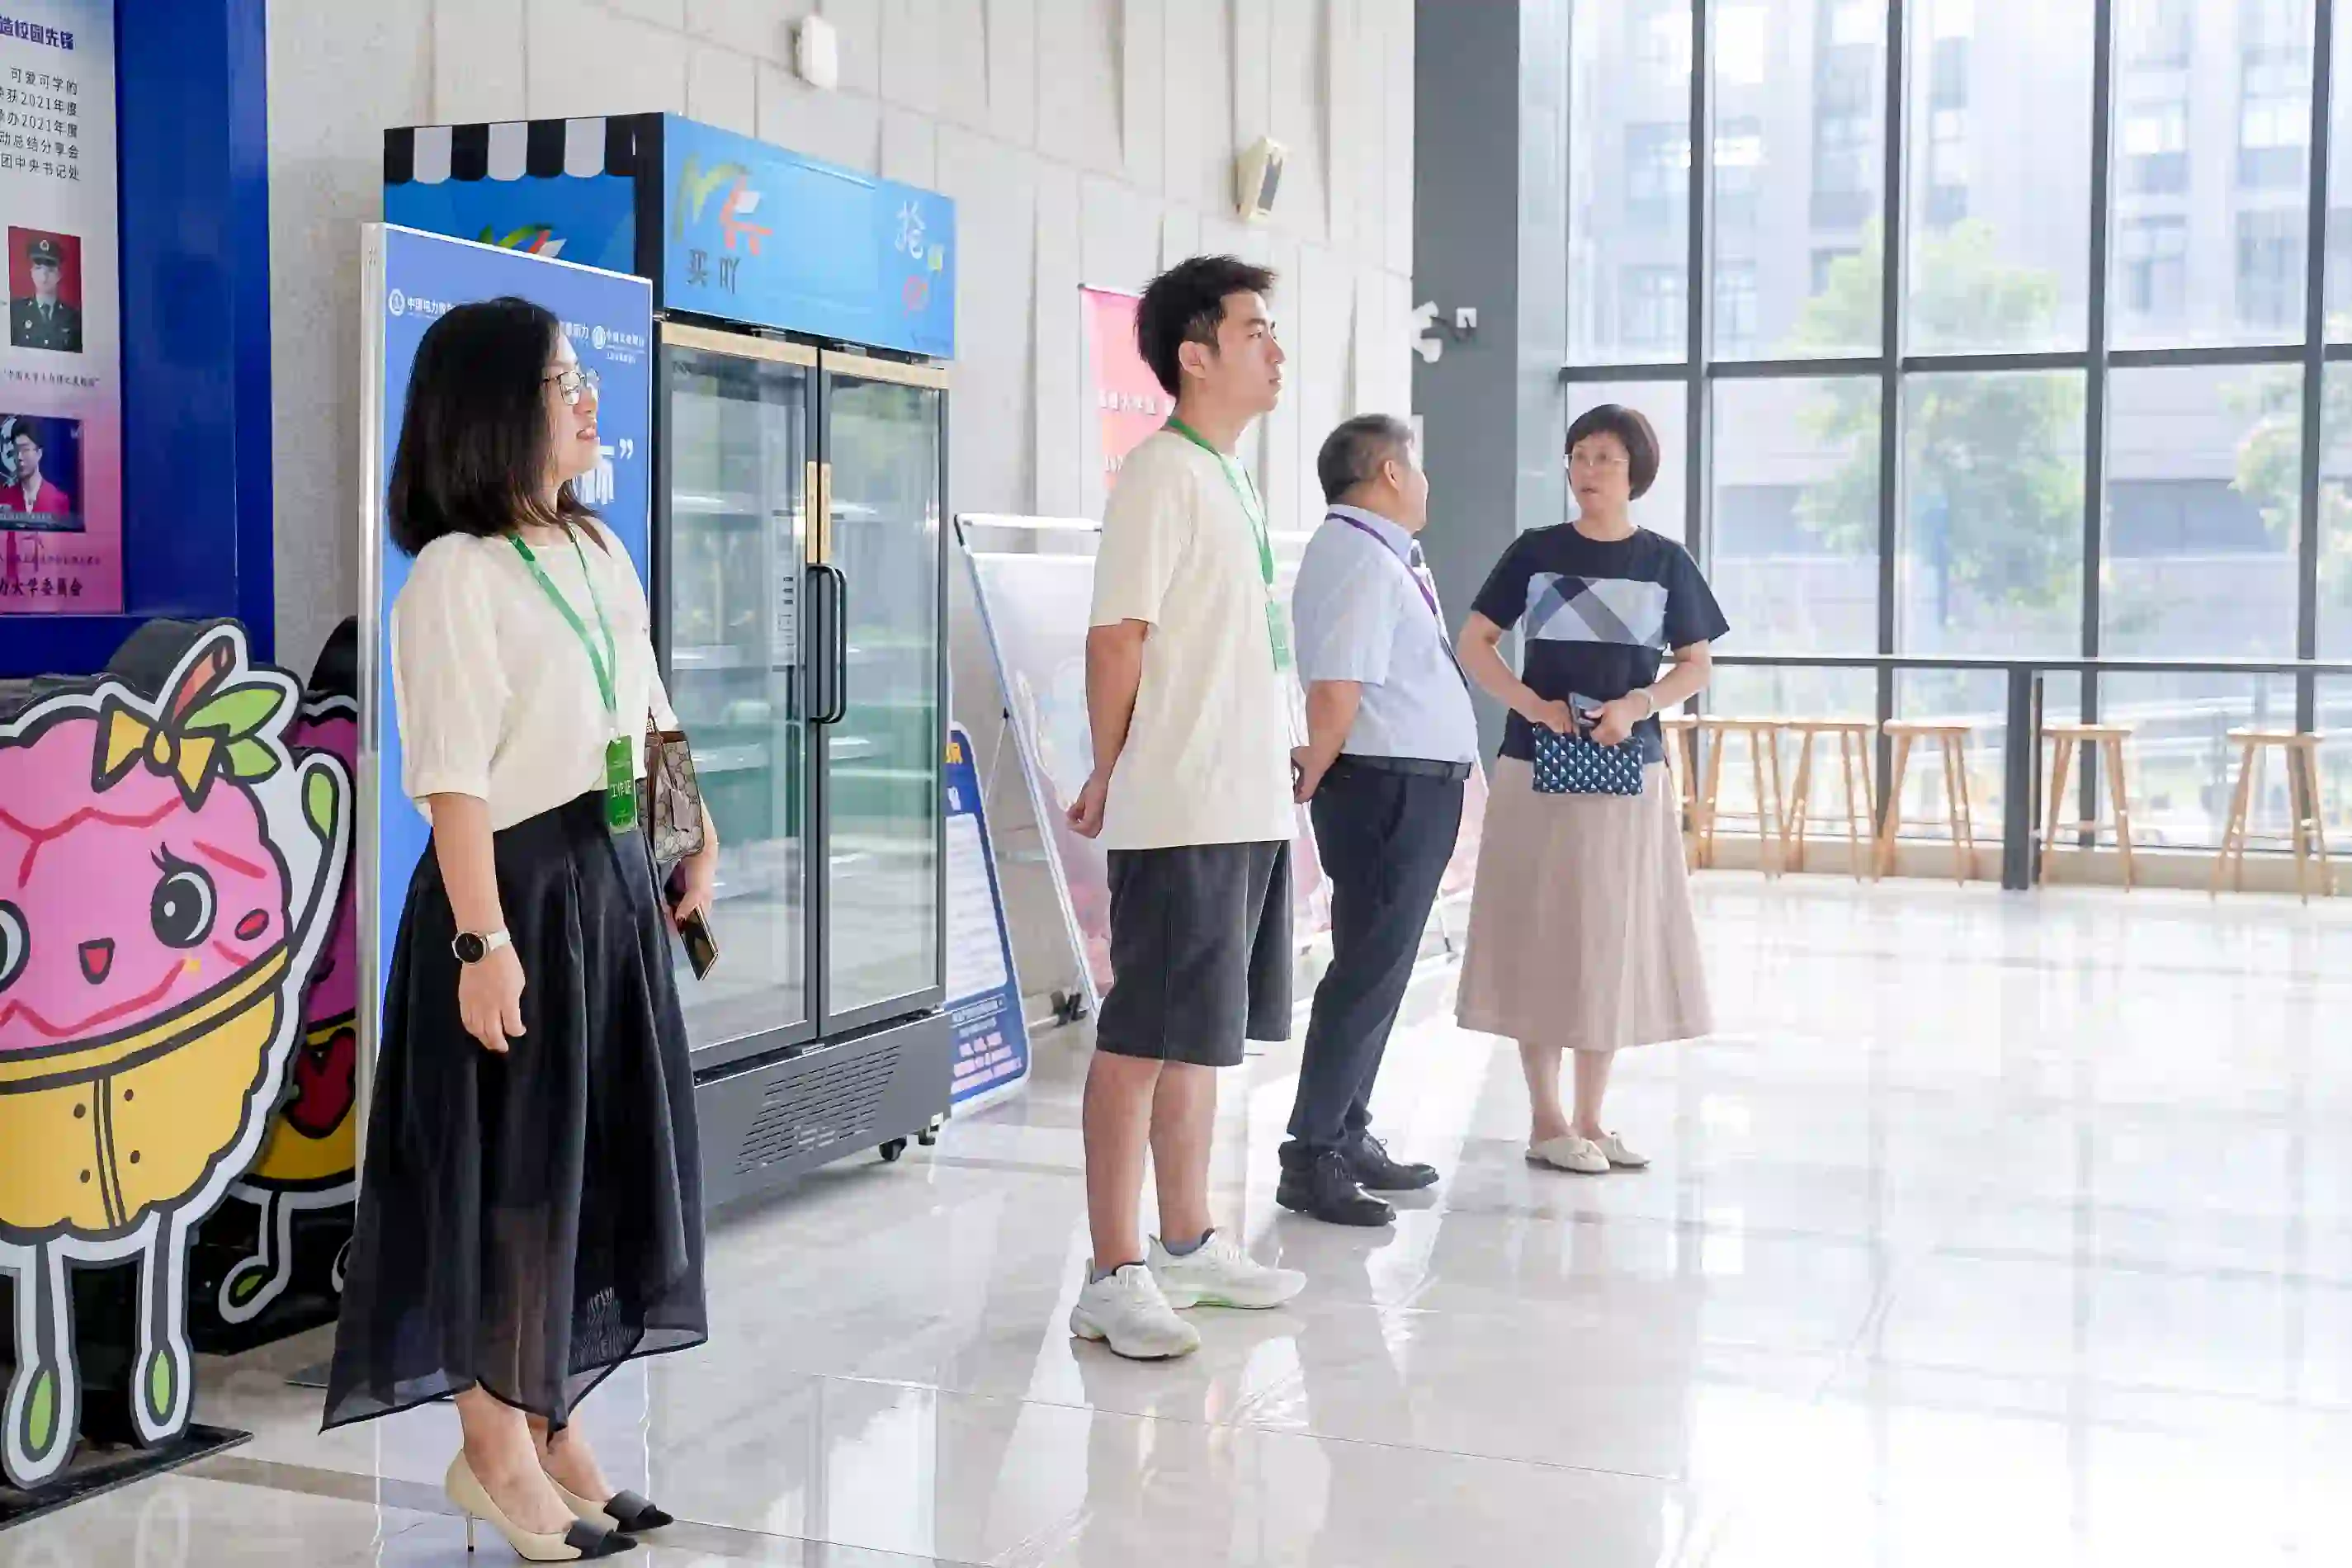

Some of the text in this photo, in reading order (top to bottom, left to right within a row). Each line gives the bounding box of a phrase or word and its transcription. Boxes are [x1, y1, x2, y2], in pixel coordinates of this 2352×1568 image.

[2, 153, 81, 182] 团中央书记处
